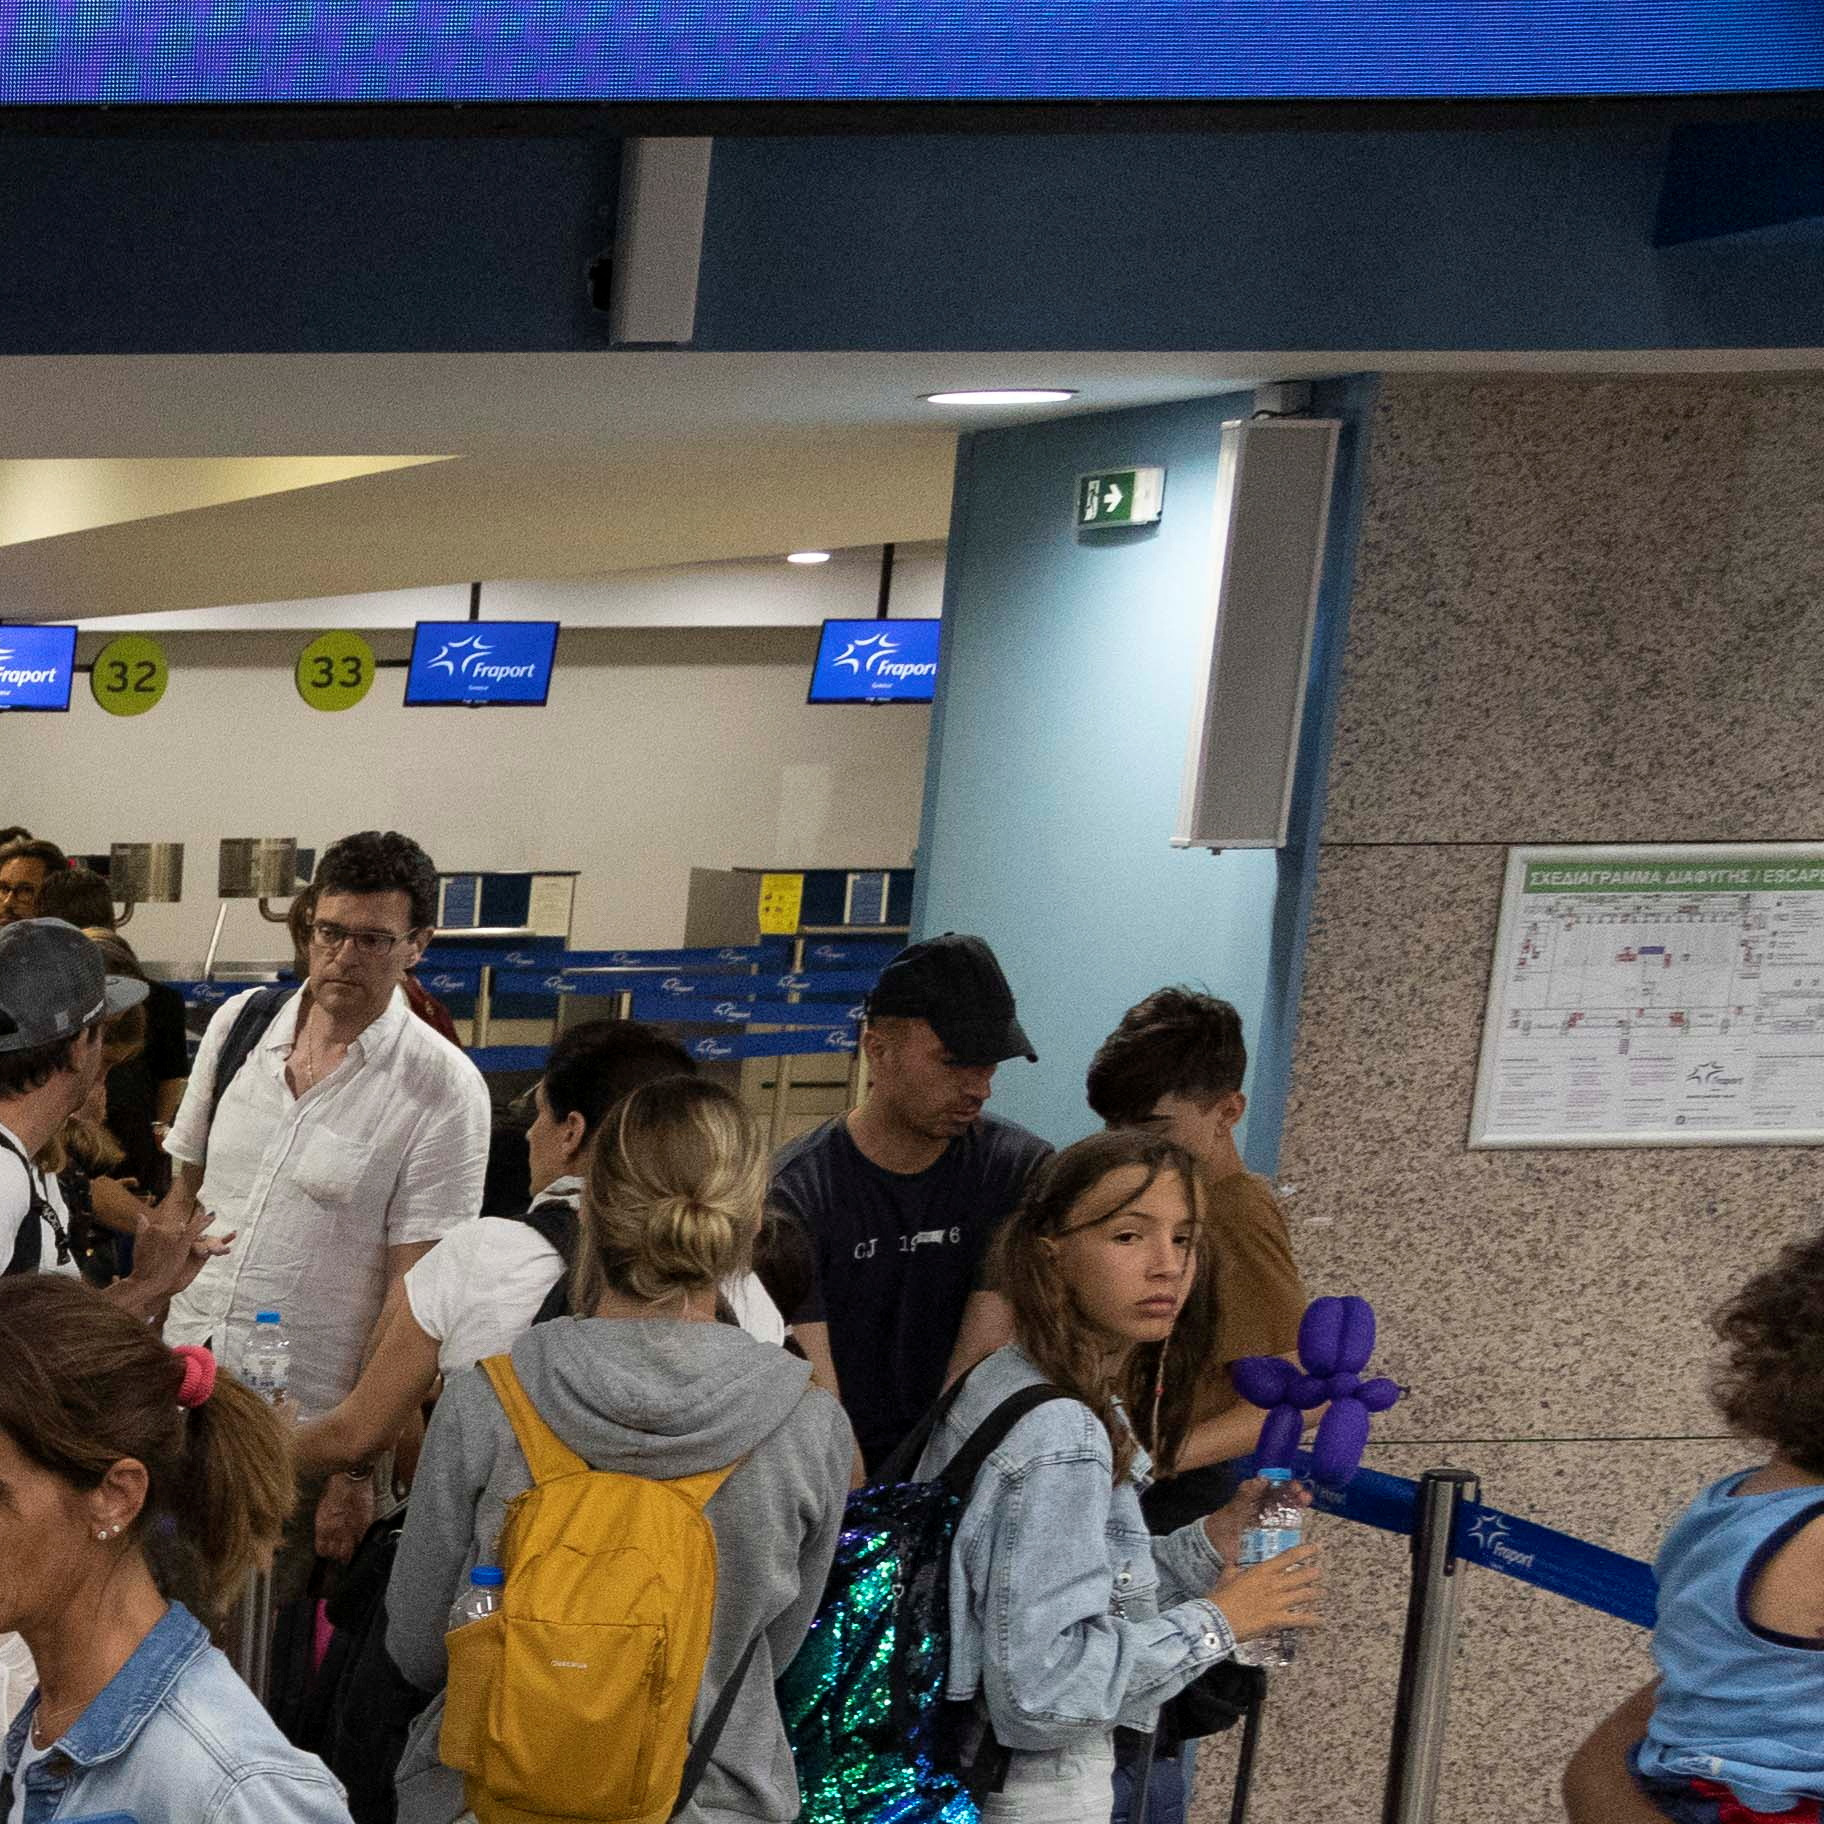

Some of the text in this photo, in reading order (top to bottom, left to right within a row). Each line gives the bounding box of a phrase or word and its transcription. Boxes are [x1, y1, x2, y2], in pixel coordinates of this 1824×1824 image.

[106, 661, 158, 693] 32
[310, 655, 362, 689] 33
[472, 662, 536, 683] Fraport
[1529, 870, 1661, 886] ΣΧΕΔΙΑΓΡΑΜΜΑ
[1665, 868, 1749, 885] ΔΙΑΦΥΓΗΣ
[854, 1238, 879, 1259] CJ
[1492, 1541, 1536, 1569] Fraport
